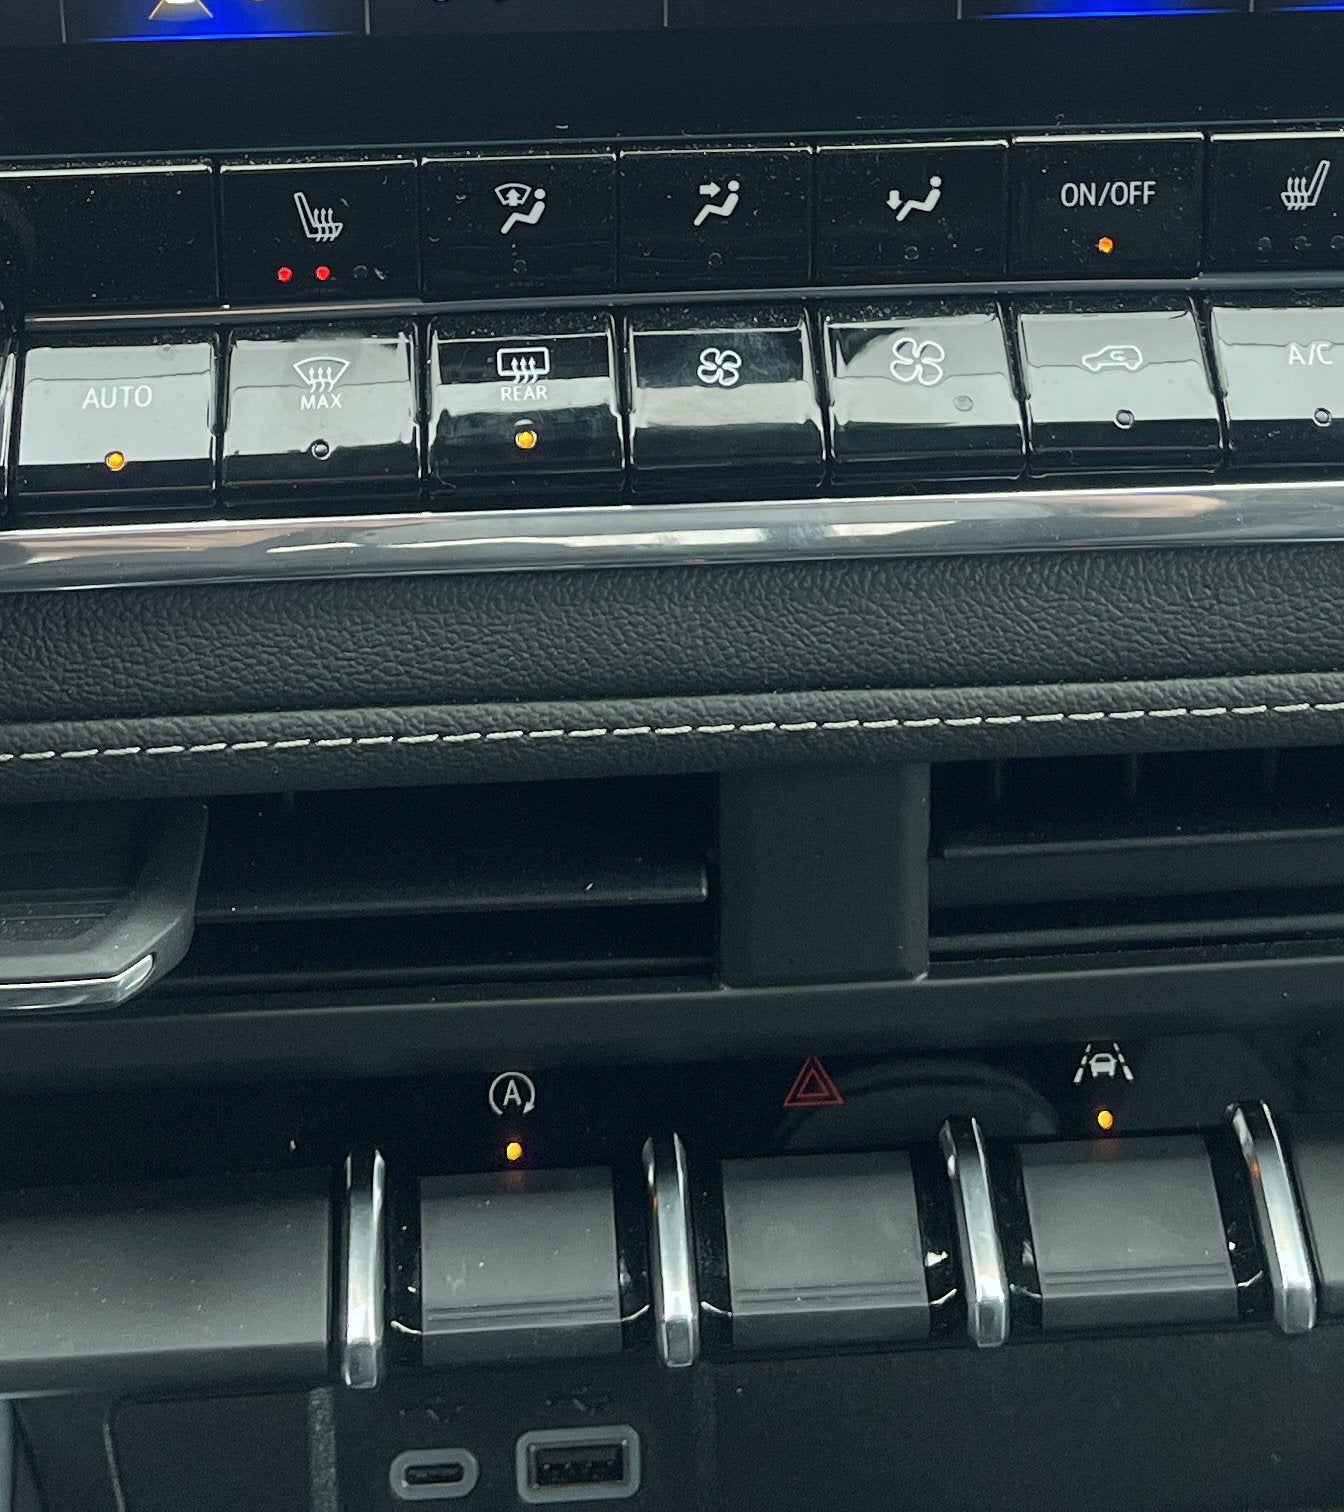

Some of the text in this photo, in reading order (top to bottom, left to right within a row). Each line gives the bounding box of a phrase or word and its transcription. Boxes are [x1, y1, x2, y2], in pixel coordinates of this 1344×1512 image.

[1060, 180, 1157, 207] ON/OFF
[1288, 342, 1333, 366] A/C
[81, 384, 153, 410] AUTO
[299, 393, 343, 410] MAX
[501, 385, 548, 403] REAR
